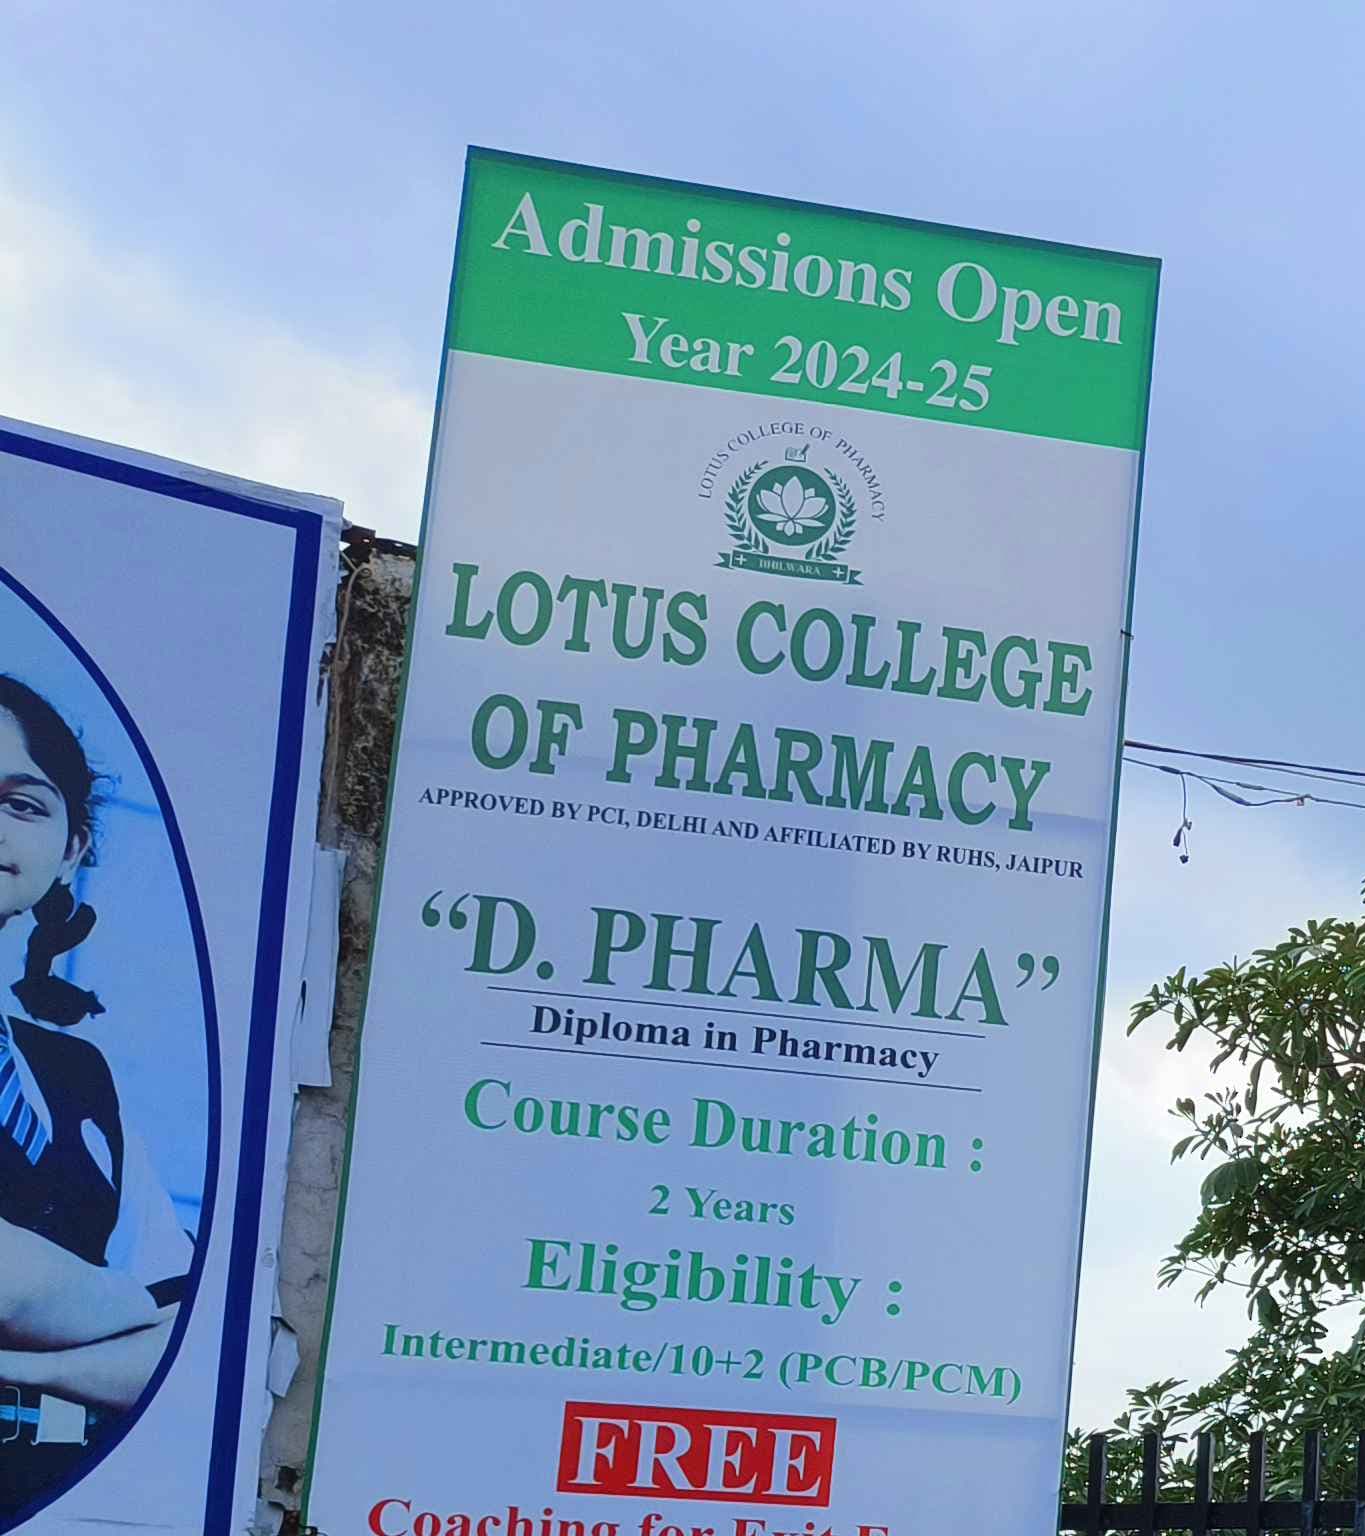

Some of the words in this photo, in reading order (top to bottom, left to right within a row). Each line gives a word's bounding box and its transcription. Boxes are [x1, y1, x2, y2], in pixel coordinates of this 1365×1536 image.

[491, 190, 914, 313] Admissions
[936, 262, 1123, 346] Open
[621, 312, 754, 378] Year
[771, 335, 992, 412] 2024-25
[698, 450, 729, 499] LOTUS
[727, 422, 805, 452] COLLEGE
[809, 426, 833, 441] OF
[835, 438, 885, 523] PHARMACY
[445, 562, 709, 666] LOTUS
[736, 600, 1093, 717] COLLEGE
[472, 693, 583, 774] OF
[606, 708, 1051, 832] PHARMACY
[418, 788, 545, 818] APPROVED
[550, 800, 582, 821] BY
[586, 804, 630, 830] PCI,
[636, 809, 709, 836] DELHI
[711, 818, 759, 841] AND
[762, 823, 898, 857] AFFILIATED
[902, 839, 933, 861] BY
[935, 843, 1000, 872] RUHS,
[1005, 850, 1085, 880] JAIPUR
[529, 1004, 691, 1050] Diploma
[704, 1021, 739, 1054] in
[752, 1026, 940, 1079] Pharmacy
[463, 1078, 671, 1145] Course
[690, 1098, 948, 1170] Duration
[649, 1184, 671, 1216] 2
[685, 1187, 796, 1228] Years
[521, 1238, 862, 1326] Eligibility
[381, 1322, 766, 1382] Intermediate/10+2
[779, 1348, 1022, 1404] (PCB/PCM)
[566, 1415, 825, 1500] FREE
